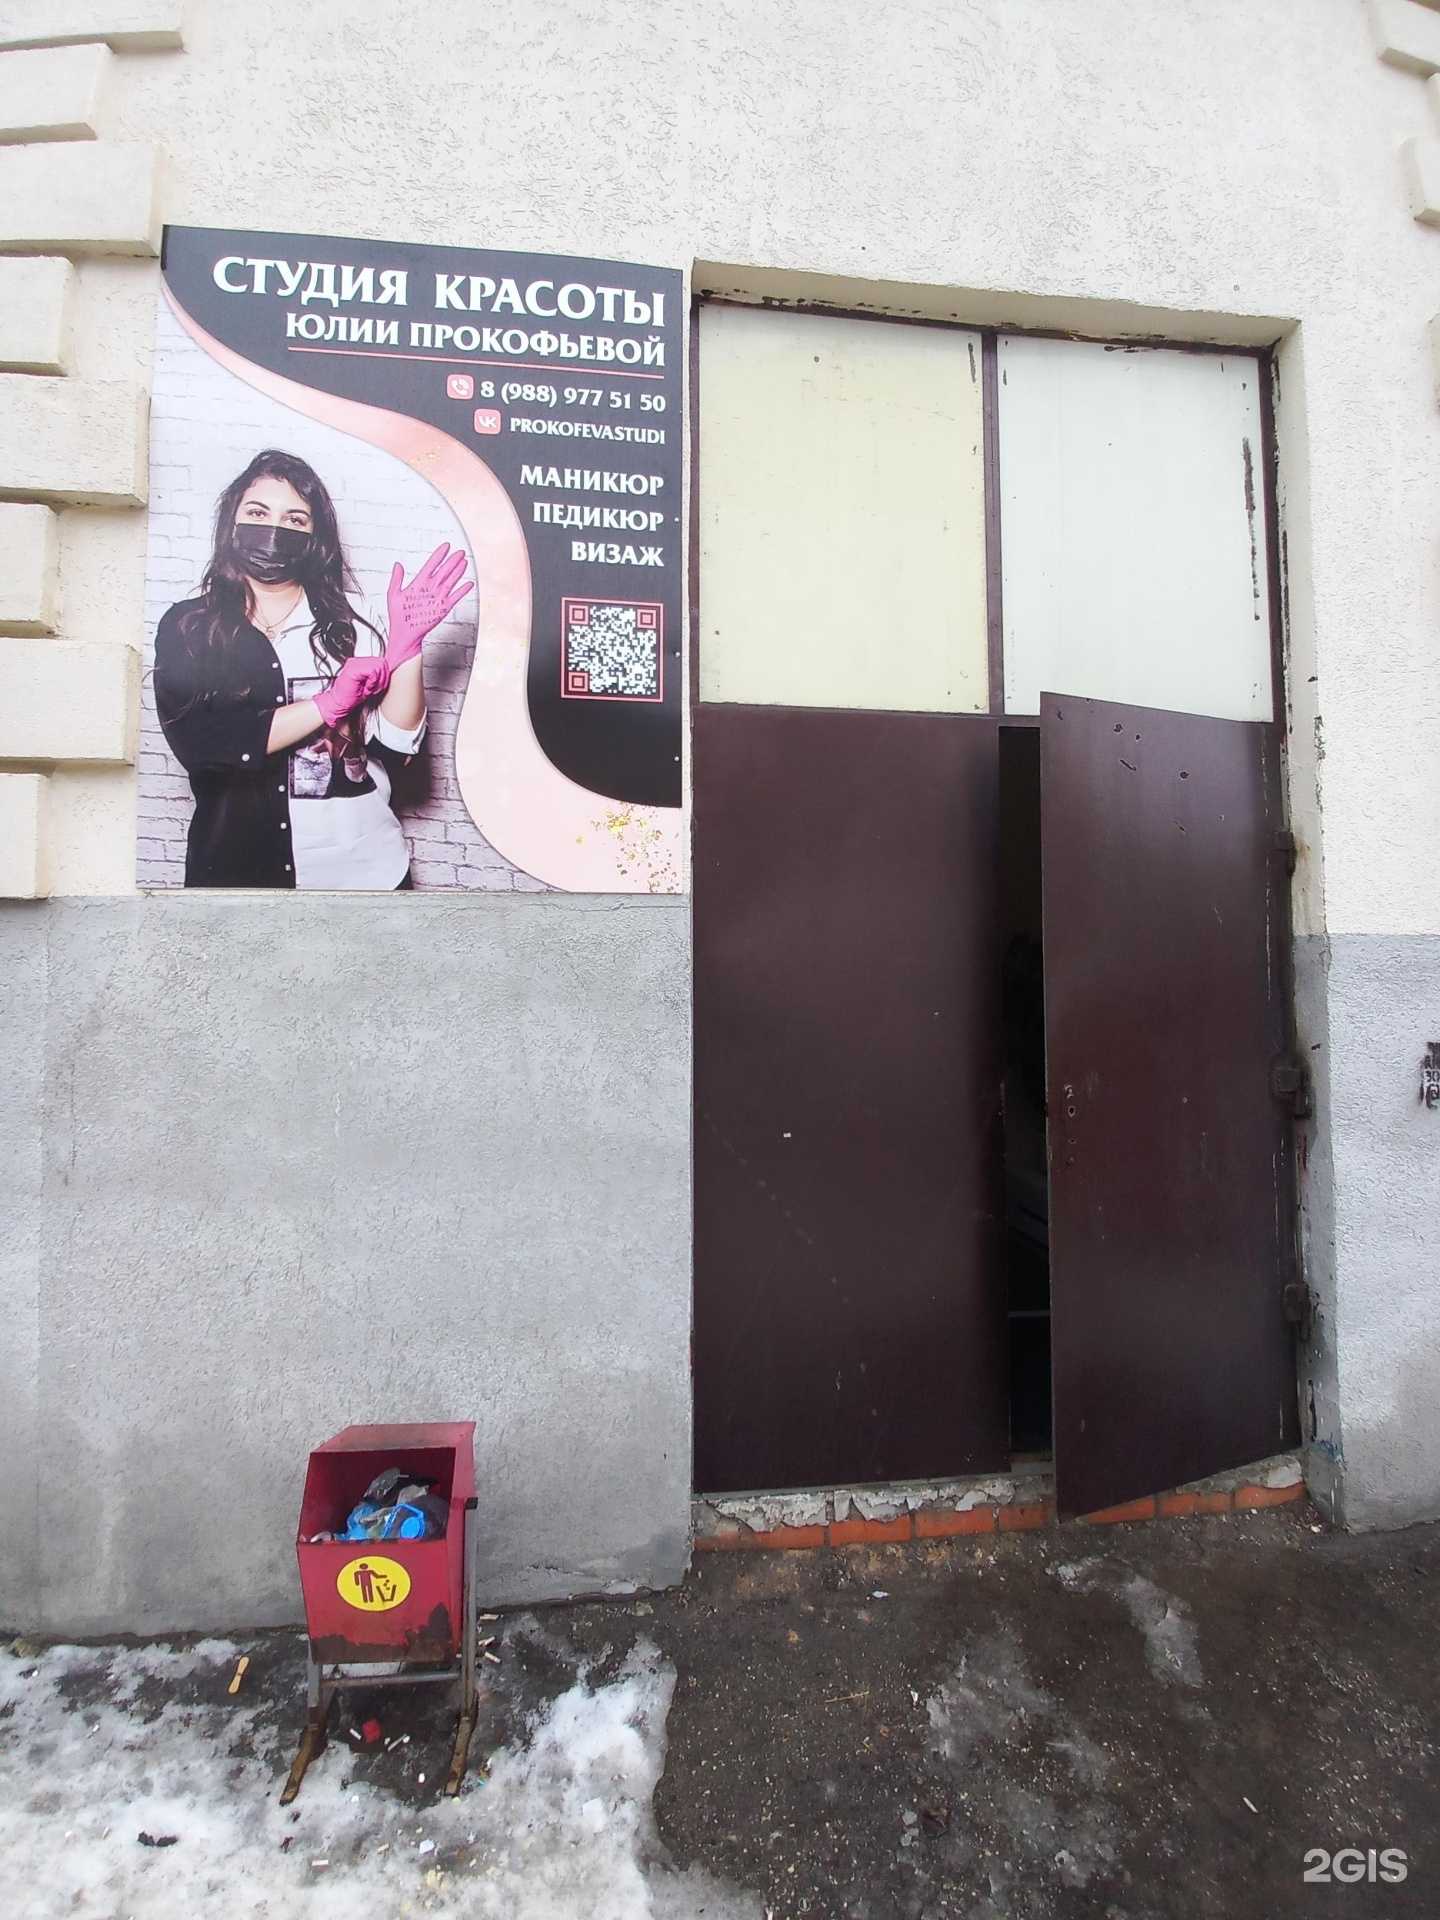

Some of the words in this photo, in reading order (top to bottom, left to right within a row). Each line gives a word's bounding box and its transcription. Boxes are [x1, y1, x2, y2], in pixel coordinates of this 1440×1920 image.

[212, 255, 408, 308] СТУДИЯ
[435, 272, 666, 328] КРАСОТЫ
[285, 313, 400, 346] ЮЛИИ
[410, 322, 666, 367] ПРОКОФЬЕВОЙ
[480, 380, 495, 398] 8
[501, 382, 558, 407] (988)
[563, 387, 603, 406] 977
[609, 391, 632, 409] 51
[640, 395, 666, 412] 50
[510, 417, 666, 444] PROKOFEVASTUDI
[520, 464, 664, 496] МАНИКЮР
[533, 502, 664, 532] ПЕДИКЮР
[571, 541, 665, 567] ВИЗАЖ
